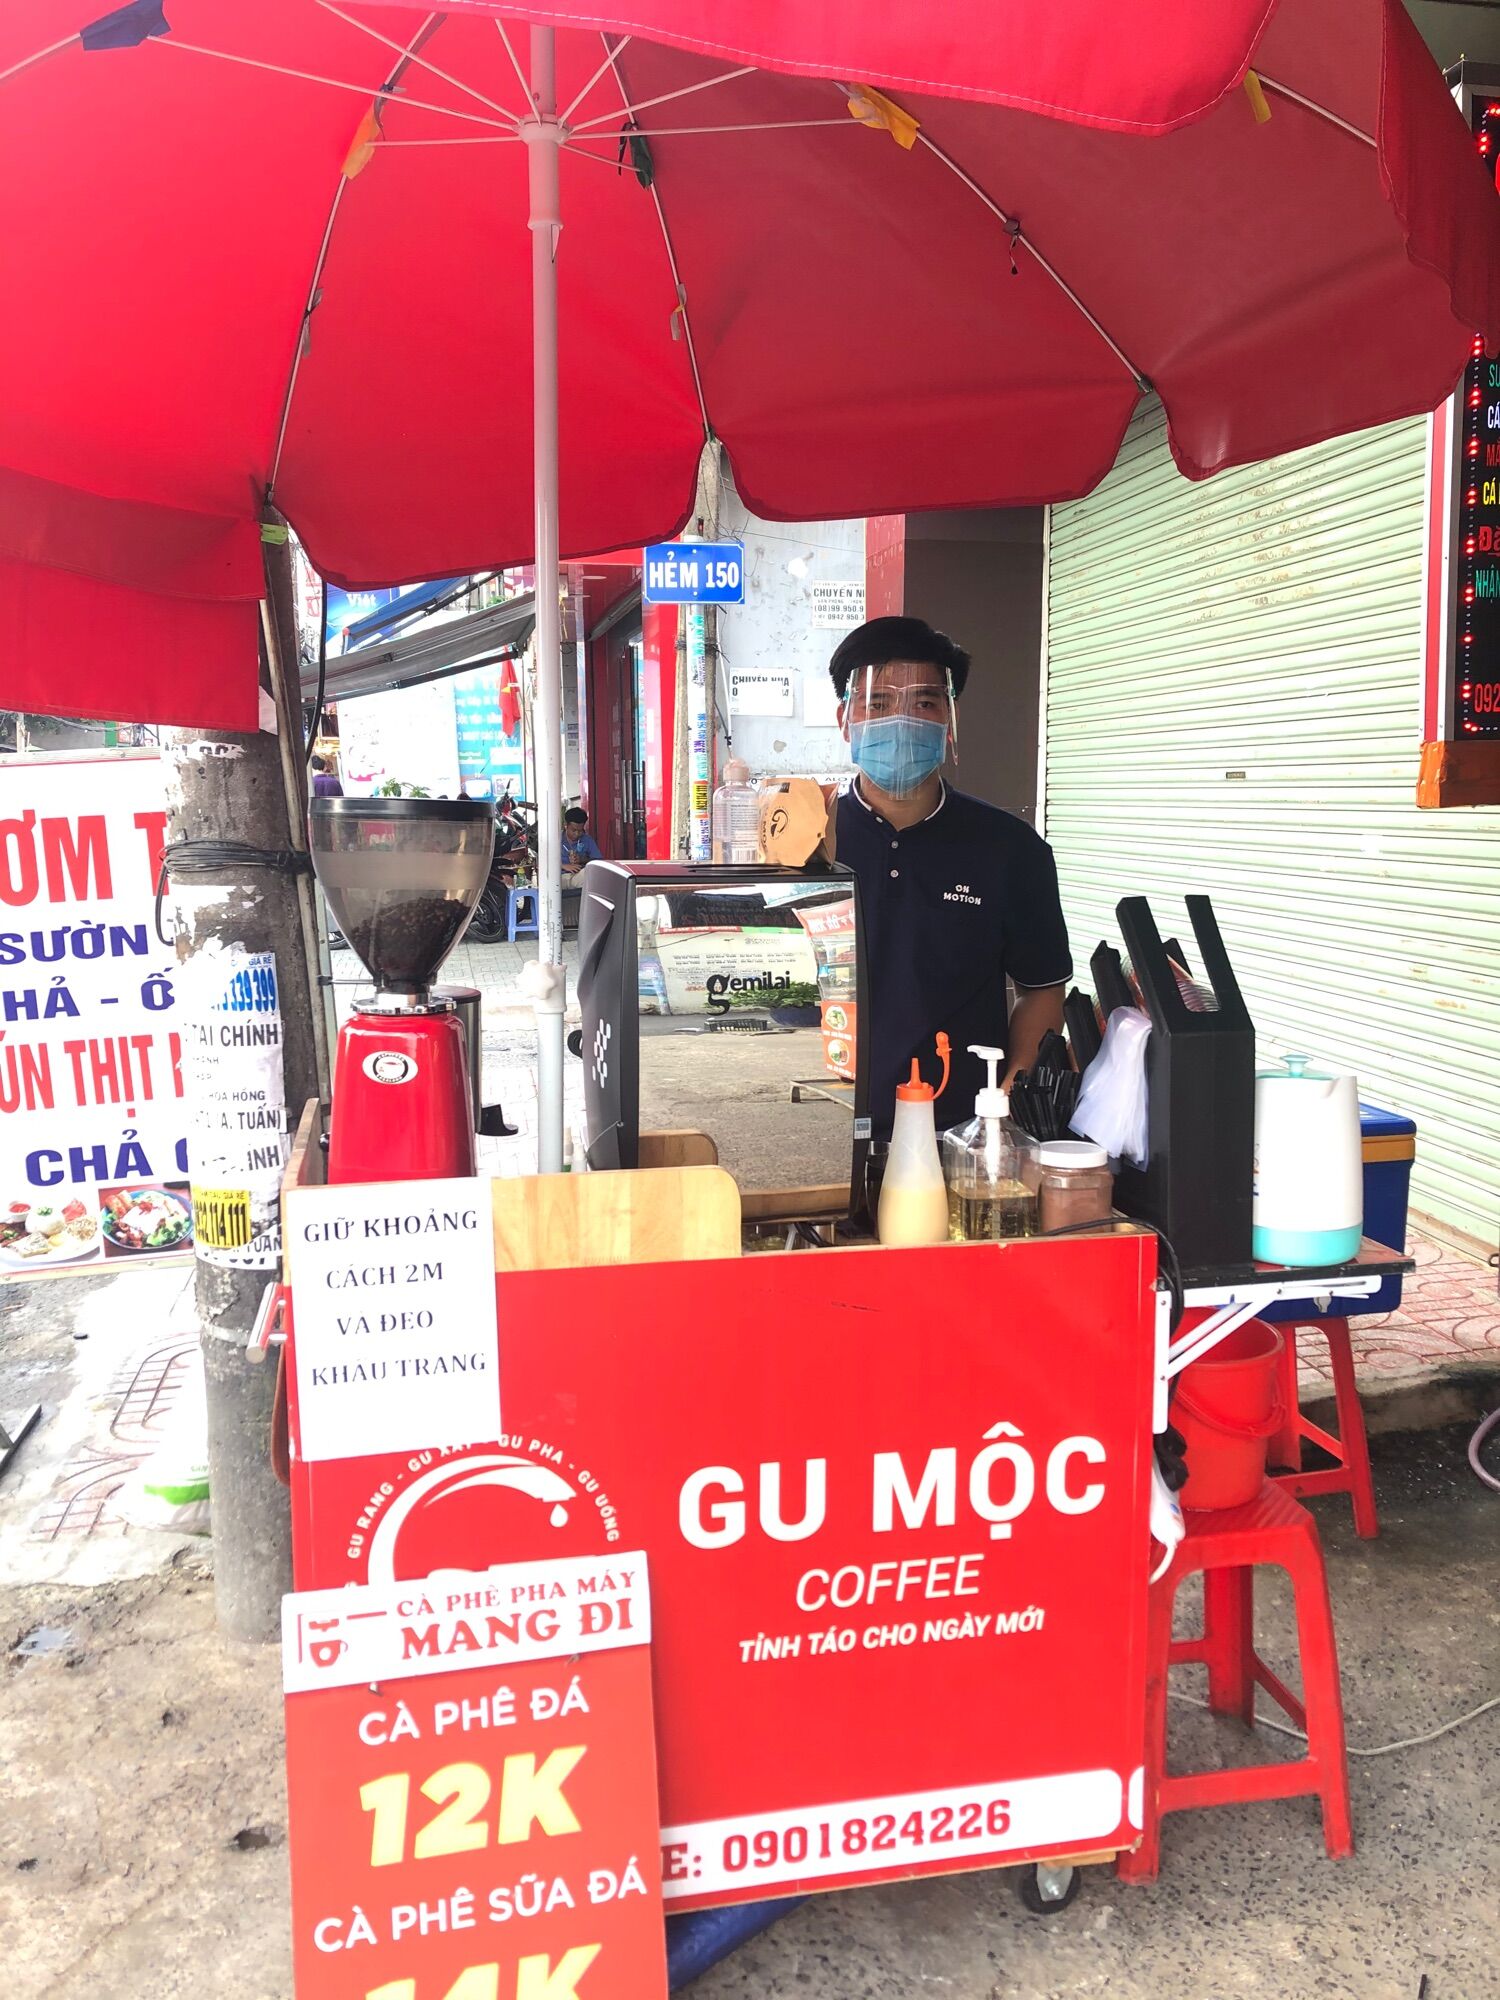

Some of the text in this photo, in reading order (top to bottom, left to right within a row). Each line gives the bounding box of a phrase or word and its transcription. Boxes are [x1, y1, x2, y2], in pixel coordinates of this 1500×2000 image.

[649, 551, 739, 589] HẺM 150
[943, 892, 982, 906] MOTION
[955, 884, 970, 893] ON
[0, 920, 149, 965] SƯỜN
[706, 971, 791, 1016] gemilai
[220, 1019, 279, 1047] CHÍNH
[63, 1034, 154, 1118] THỊT
[26, 1129, 155, 1187] CHẢ
[303, 1208, 479, 1243] GIỮ KHOẢNG
[326, 1262, 444, 1290] CÁCH 2M
[380, 1310, 435, 1333] ĐEO
[394, 1352, 487, 1378] TRANG
[347, 1533, 364, 1559] GU
[356, 1481, 395, 1530] RANG
[407, 1450, 433, 1473] GU
[497, 1433, 524, 1449] GU
[528, 1438, 565, 1464] PHA
[577, 1470, 600, 1493] GU
[594, 1493, 620, 1543] UỐNG
[679, 1421, 1107, 1550] GU MỘC
[396, 1593, 435, 1618] CÀ
[511, 1581, 568, 1604] PHA
[577, 1569, 637, 1596] MÁY
[795, 1553, 986, 1613] COFFEE
[401, 1597, 634, 1661] MANG ĐI
[739, 1605, 1046, 1663] TỈNH TÁO CHO NGÀY MỚI
[358, 1675, 590, 1746] CÀ PHÊ ĐÁ
[359, 1744, 588, 1868] 12K
[722, 1799, 1011, 1874] 0901824226
[313, 1856, 647, 1953] CÀ PHÊ SỮA ĐÁ
